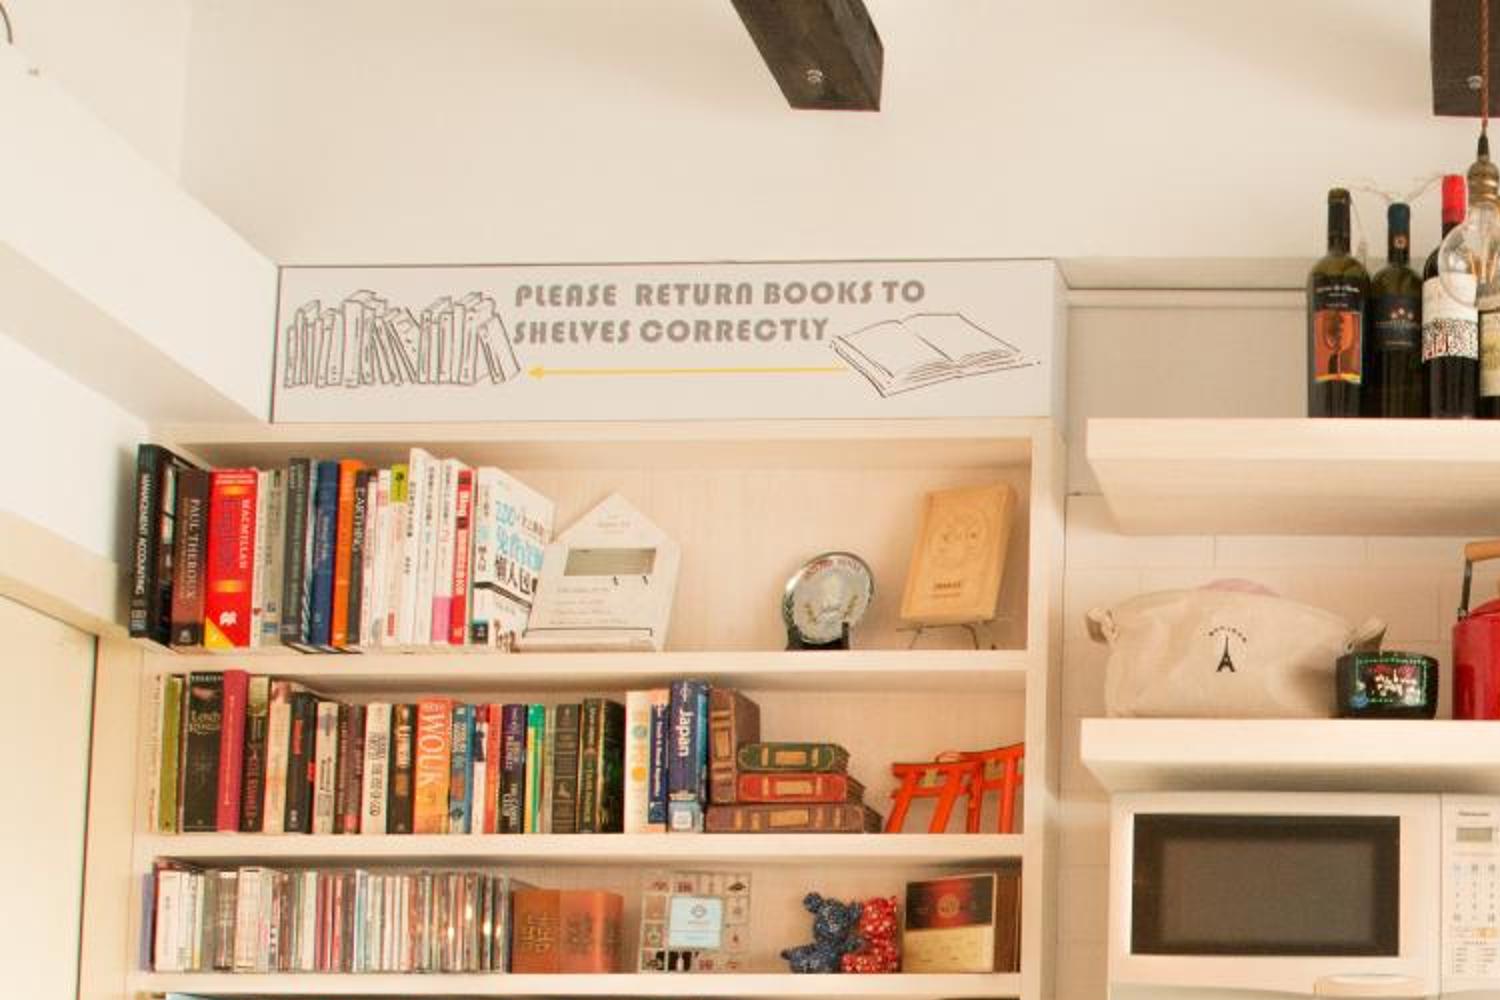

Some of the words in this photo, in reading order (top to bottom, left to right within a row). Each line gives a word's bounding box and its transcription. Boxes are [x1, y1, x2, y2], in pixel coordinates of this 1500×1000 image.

[515, 285, 617, 307] PLEASE
[636, 282, 753, 306] RETURN
[764, 280, 874, 304] BOOKS
[883, 280, 925, 303] TO
[514, 319, 630, 344] SHELVES
[640, 317, 829, 343] CORRECTLY
[189, 498, 200, 531] PAUL
[239, 498, 250, 569] MACMILLAN
[186, 534, 199, 600] THEROUX
[418, 713, 446, 788] WOUK
[676, 708, 695, 757] Japan
